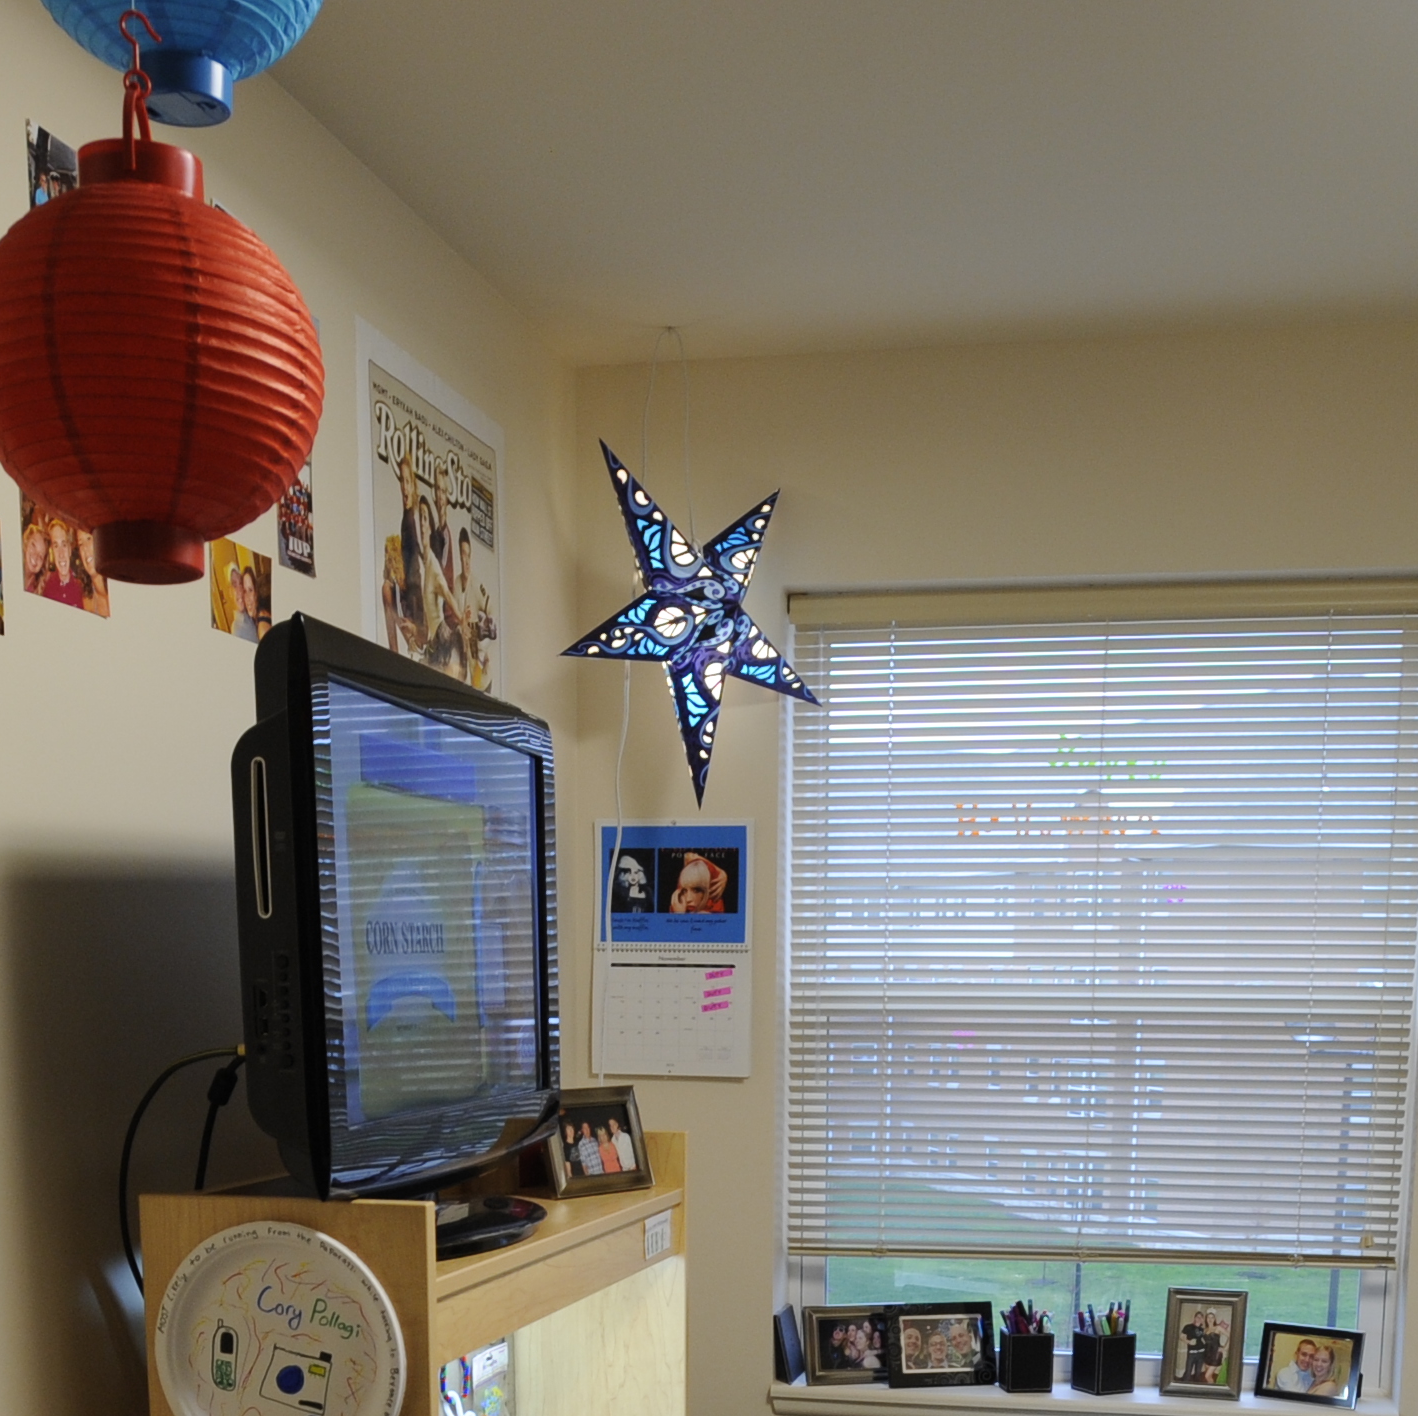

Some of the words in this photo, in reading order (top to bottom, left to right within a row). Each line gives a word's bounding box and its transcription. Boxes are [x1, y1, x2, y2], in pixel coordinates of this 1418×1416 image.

[288, 535, 311, 557] IUP
[366, 920, 398, 955] CORN
[401, 921, 445, 955] STARCH
[189, 1254, 201, 1266] to
[204, 1243, 217, 1254] be
[223, 1229, 259, 1244] running
[296, 1233, 313, 1245] the
[257, 1285, 303, 1331] Cory
[309, 1298, 362, 1340] Pollagi
